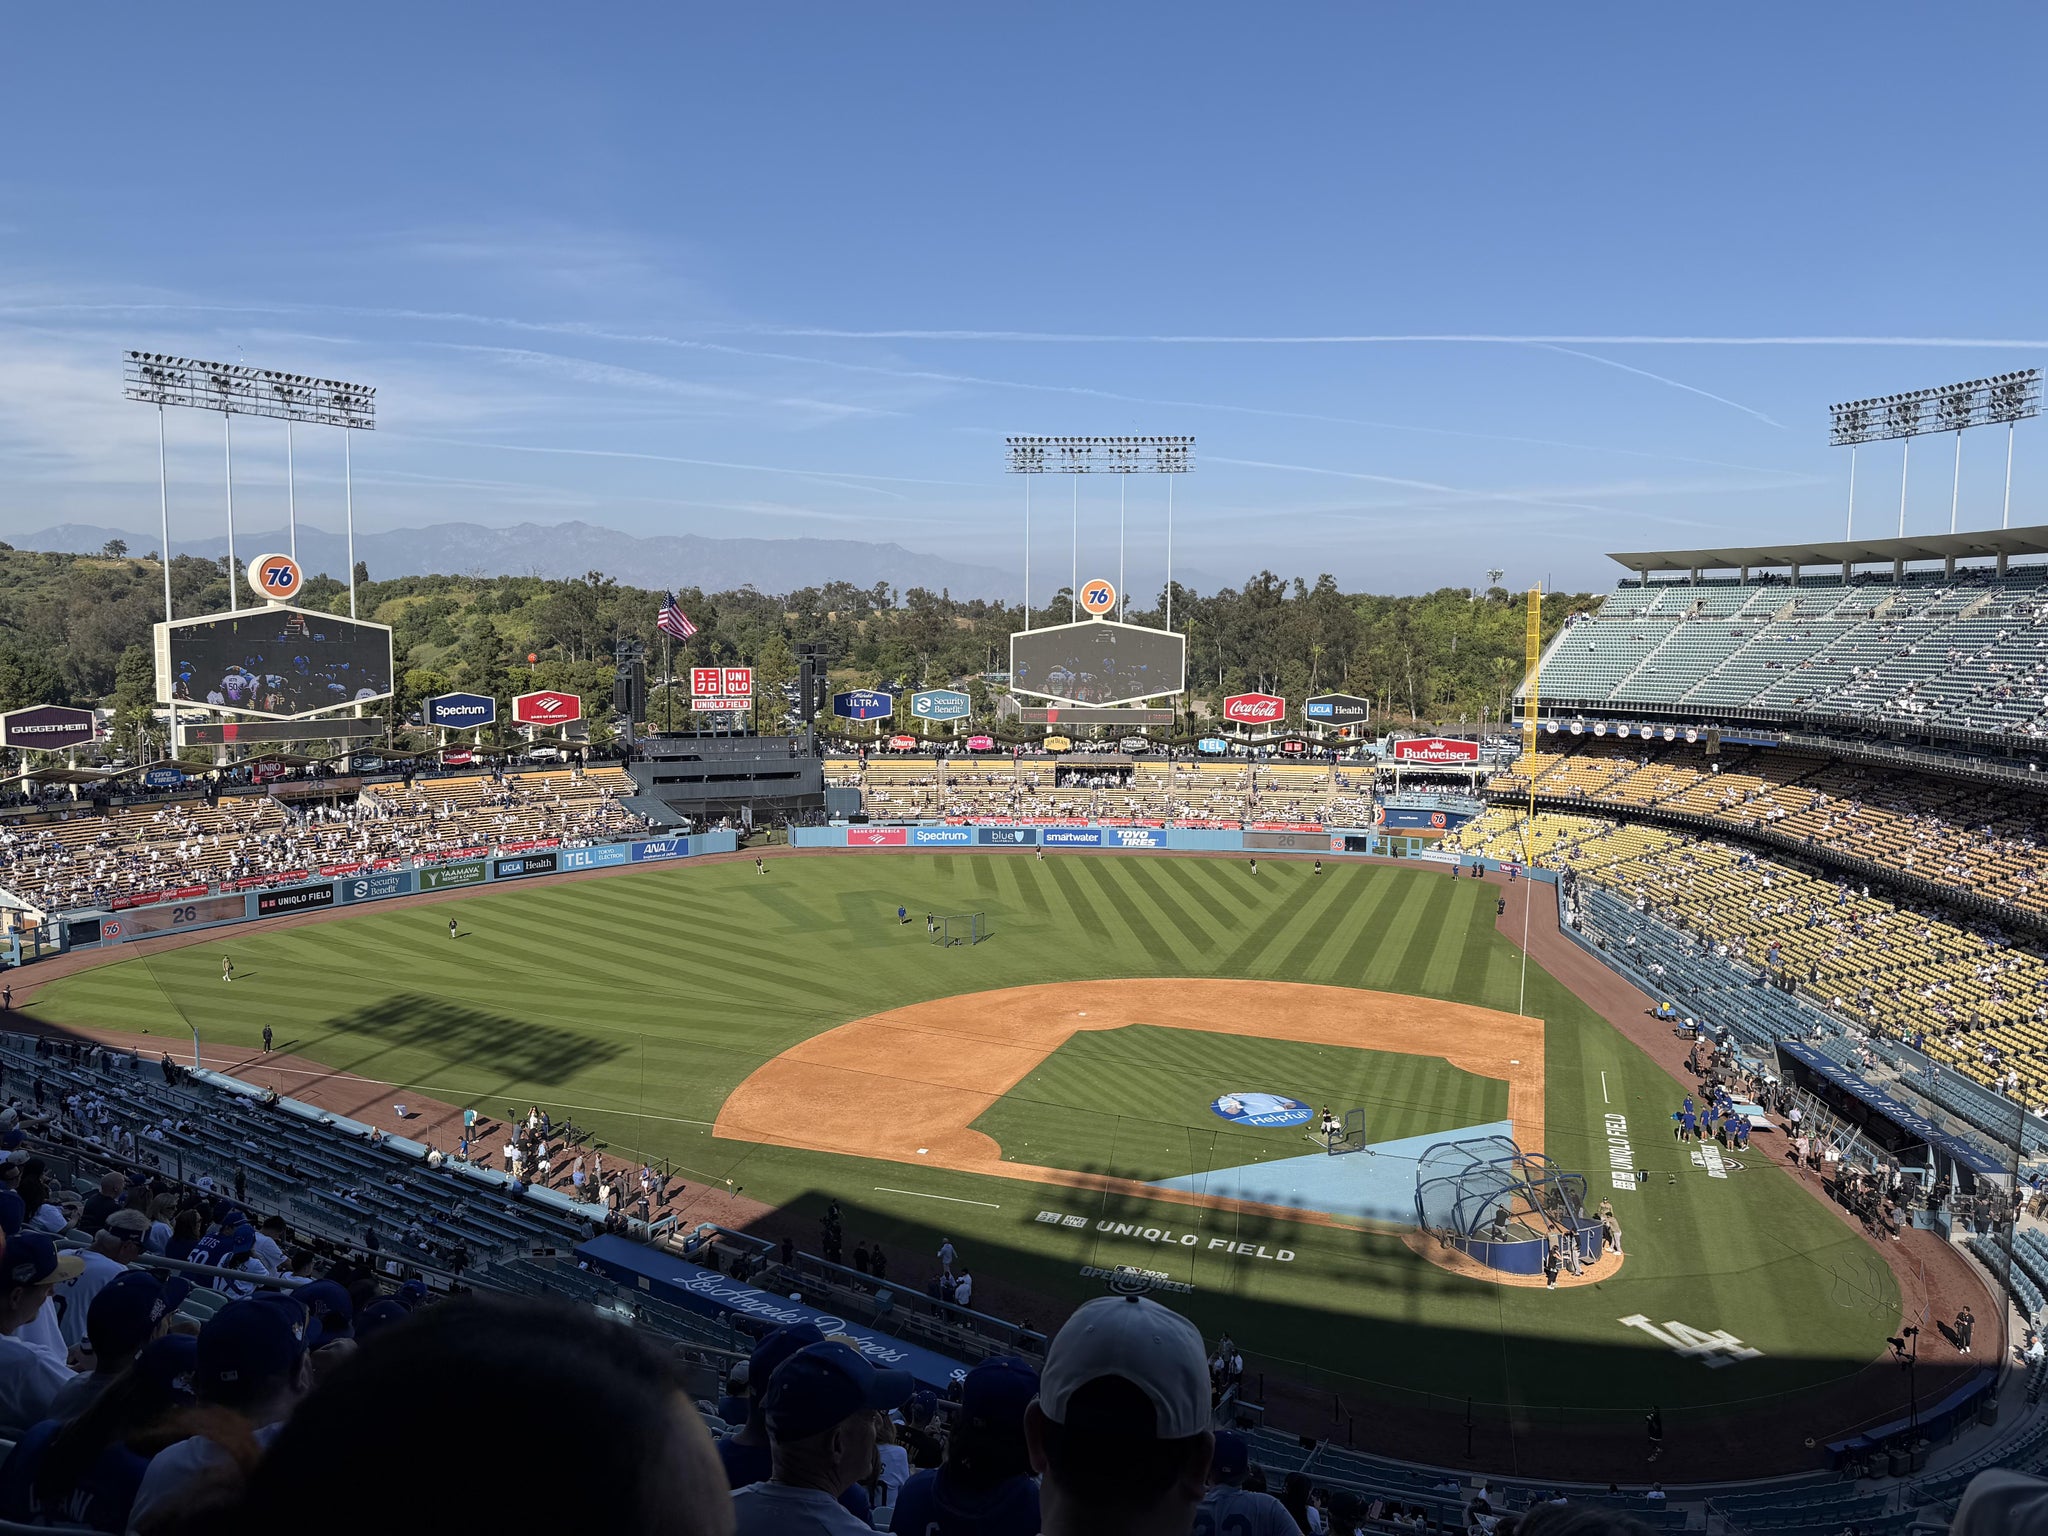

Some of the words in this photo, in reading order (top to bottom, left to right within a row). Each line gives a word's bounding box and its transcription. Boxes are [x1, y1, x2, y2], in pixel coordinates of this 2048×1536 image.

[266, 567, 294, 586] 76
[1089, 589, 1108, 604] 76
[728, 672, 746, 680] UNI
[728, 682, 748, 692] QLO
[934, 697, 964, 705] Security
[436, 705, 484, 717] Spectrum
[1230, 700, 1278, 716] Coca-Cola
[1335, 706, 1363, 714] Health
[11, 724, 88, 734] GUGGENHEIM
[1203, 741, 1221, 750] TEL
[258, 763, 280, 774] JINRO
[308, 780, 324, 790] 26
[1434, 815, 1444, 824] 76
[917, 831, 964, 842] Spectrum
[992, 830, 1014, 840] blue
[1046, 832, 1098, 842] smartwater
[1116, 830, 1148, 839] TOYO
[1122, 838, 1156, 846] TIRES
[1278, 836, 1295, 847] 26
[1333, 840, 1343, 848] 76
[644, 842, 666, 854] ANA
[525, 859, 552, 870] Health
[566, 852, 593, 866] TEL
[370, 876, 400, 887] Security
[370, 886, 396, 896] Benefit
[278, 894, 306, 906] UNIQLO
[308, 890, 331, 900] FIELD
[173, 906, 196, 923] 26
[104, 926, 118, 934] 76
[1821, 1066, 1880, 1098] STADIUM
[1249, 1110, 1308, 1125] Helpful
[1878, 1101, 1942, 1137] DODGER
[1605, 1113, 1628, 1137] FIELD
[1608, 1138, 1635, 1170] UNIQLO
[1096, 1220, 1199, 1246] UNIQLO
[1208, 1238, 1296, 1262] FIELD
[1080, 1266, 1148, 1286] OPENING
[1140, 1270, 1169, 1279] 2026
[673, 1271, 724, 1297] Los
[717, 1289, 808, 1325] Angeles
[1616, 1314, 1766, 1368] LA
